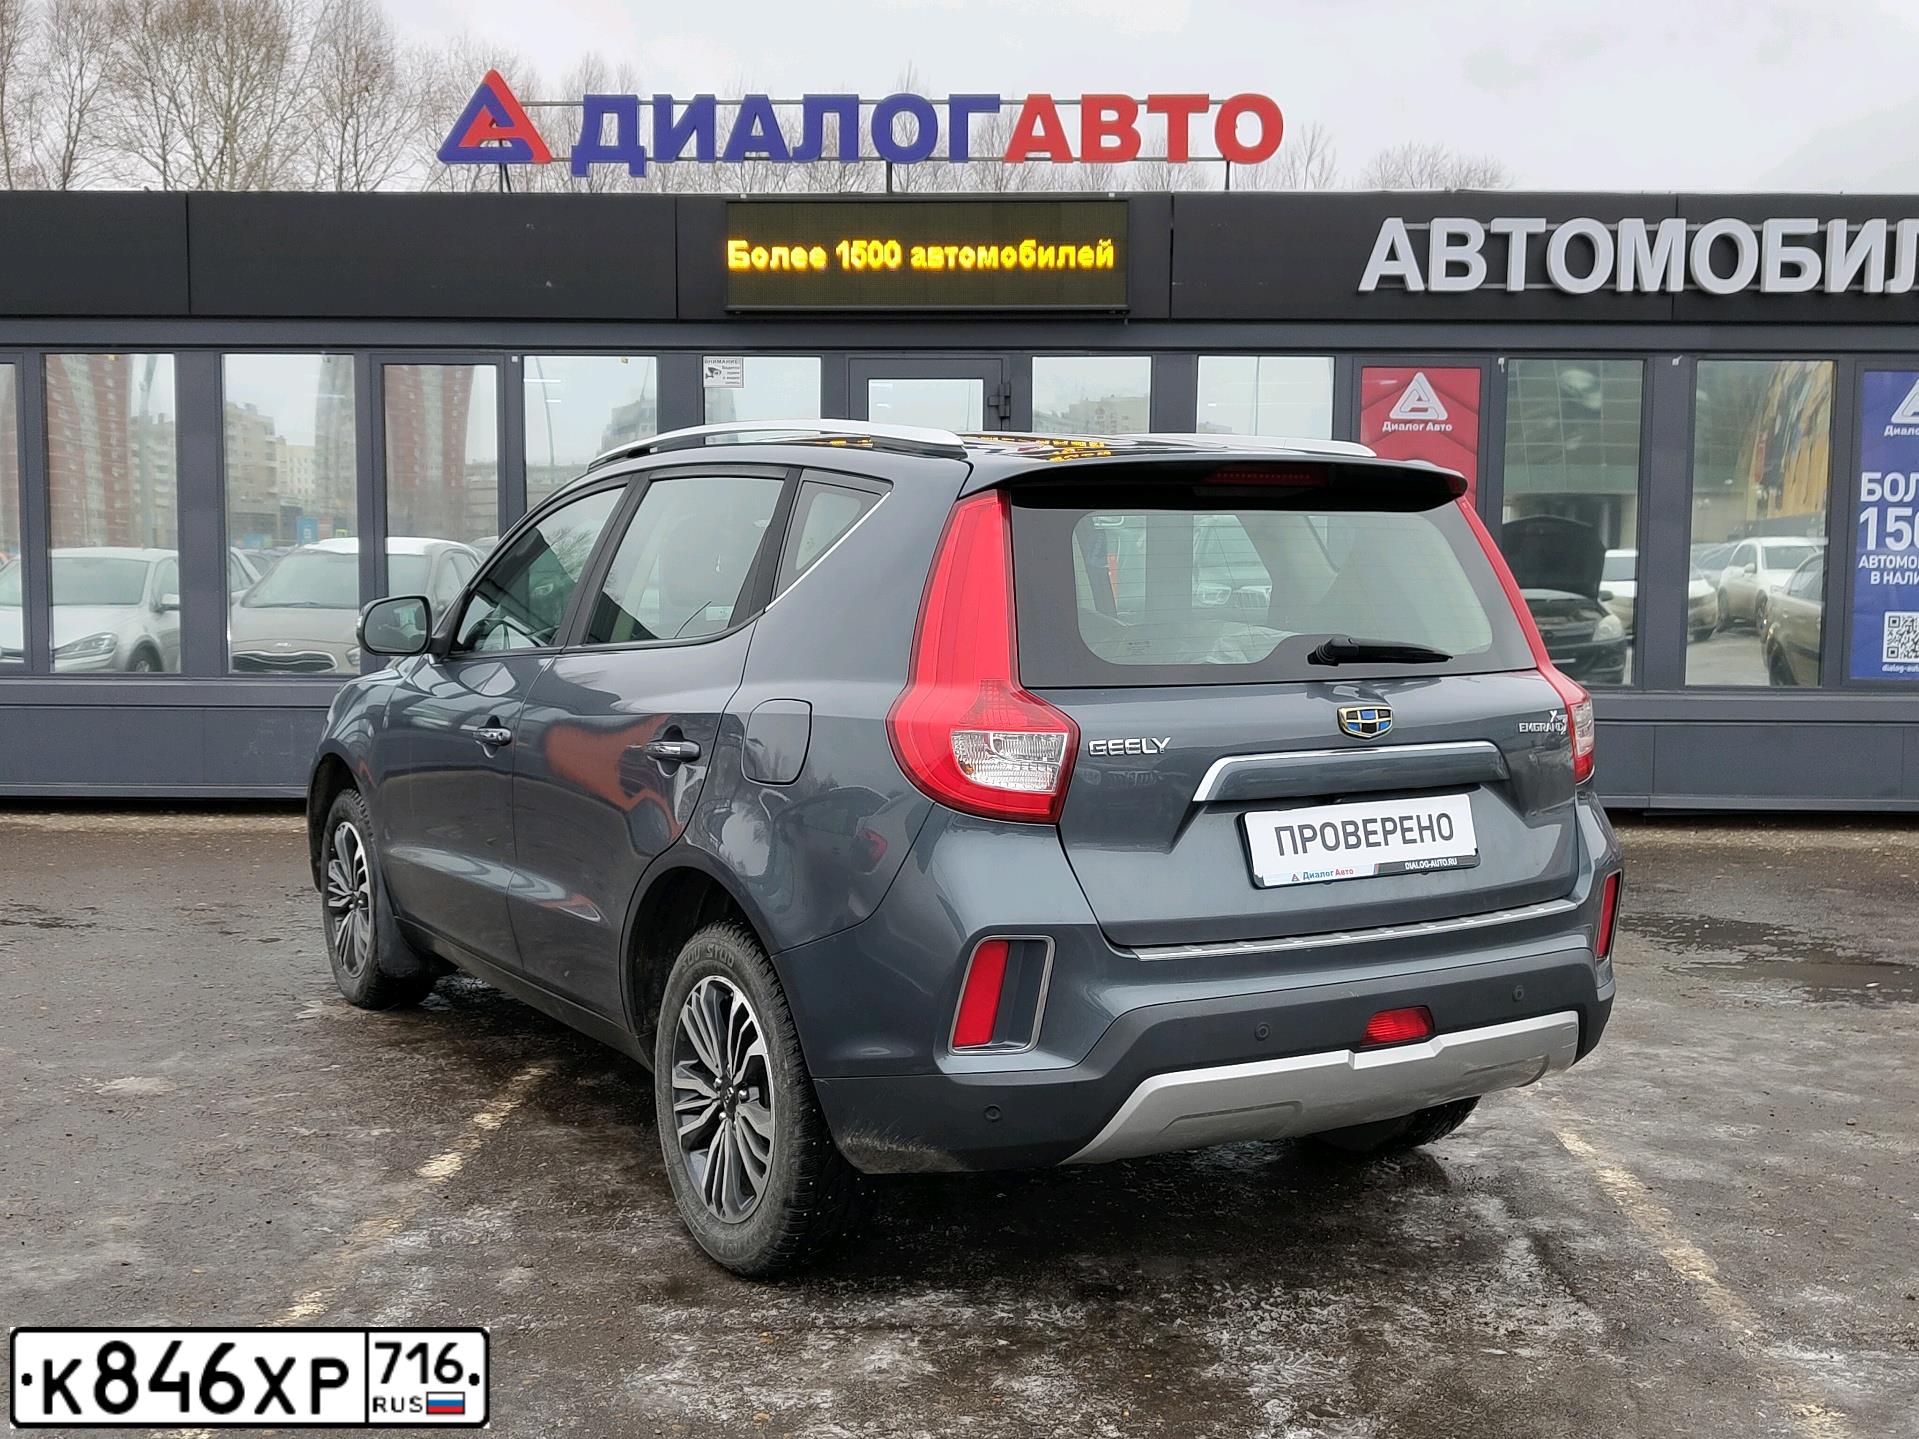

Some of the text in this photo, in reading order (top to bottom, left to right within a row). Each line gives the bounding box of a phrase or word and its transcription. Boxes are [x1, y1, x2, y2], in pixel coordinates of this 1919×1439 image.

[727, 238, 1115, 269] Более 1500 автомобилей
[1382, 421, 1453, 432] Диалог Авто
[1859, 506, 1919, 551] 15
[1858, 554, 1919, 569] АВТОМО
[1870, 571, 1881, 585] В
[1088, 736, 1171, 756] GEELY
[1274, 812, 1454, 857] ПРОВЕРЕНО
[1404, 857, 1458, 870] DIALOG-AUTO.RU
